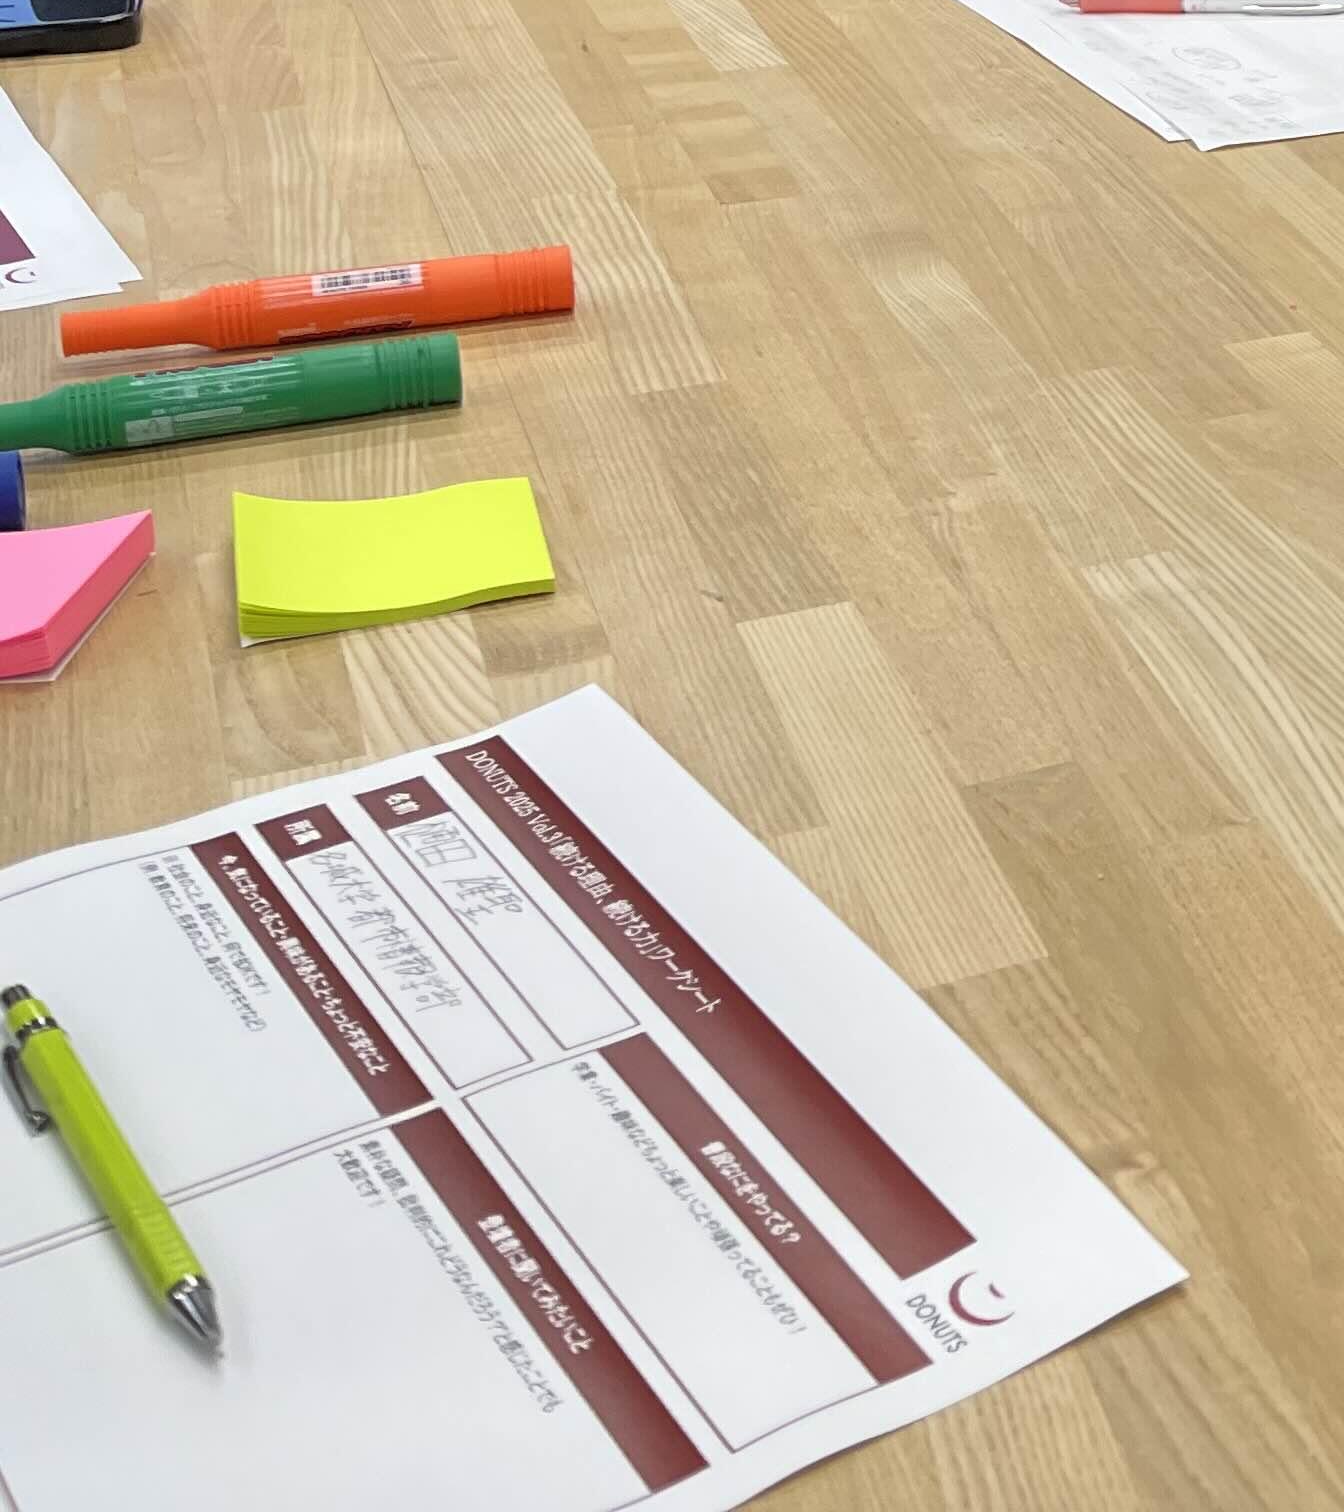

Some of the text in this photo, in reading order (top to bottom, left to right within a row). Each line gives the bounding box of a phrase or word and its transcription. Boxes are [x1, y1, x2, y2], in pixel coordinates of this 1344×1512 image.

[465, 749, 518, 794] DONUTS
[383, 791, 421, 816] 名前
[903, 1294, 970, 1355] DONUTS
